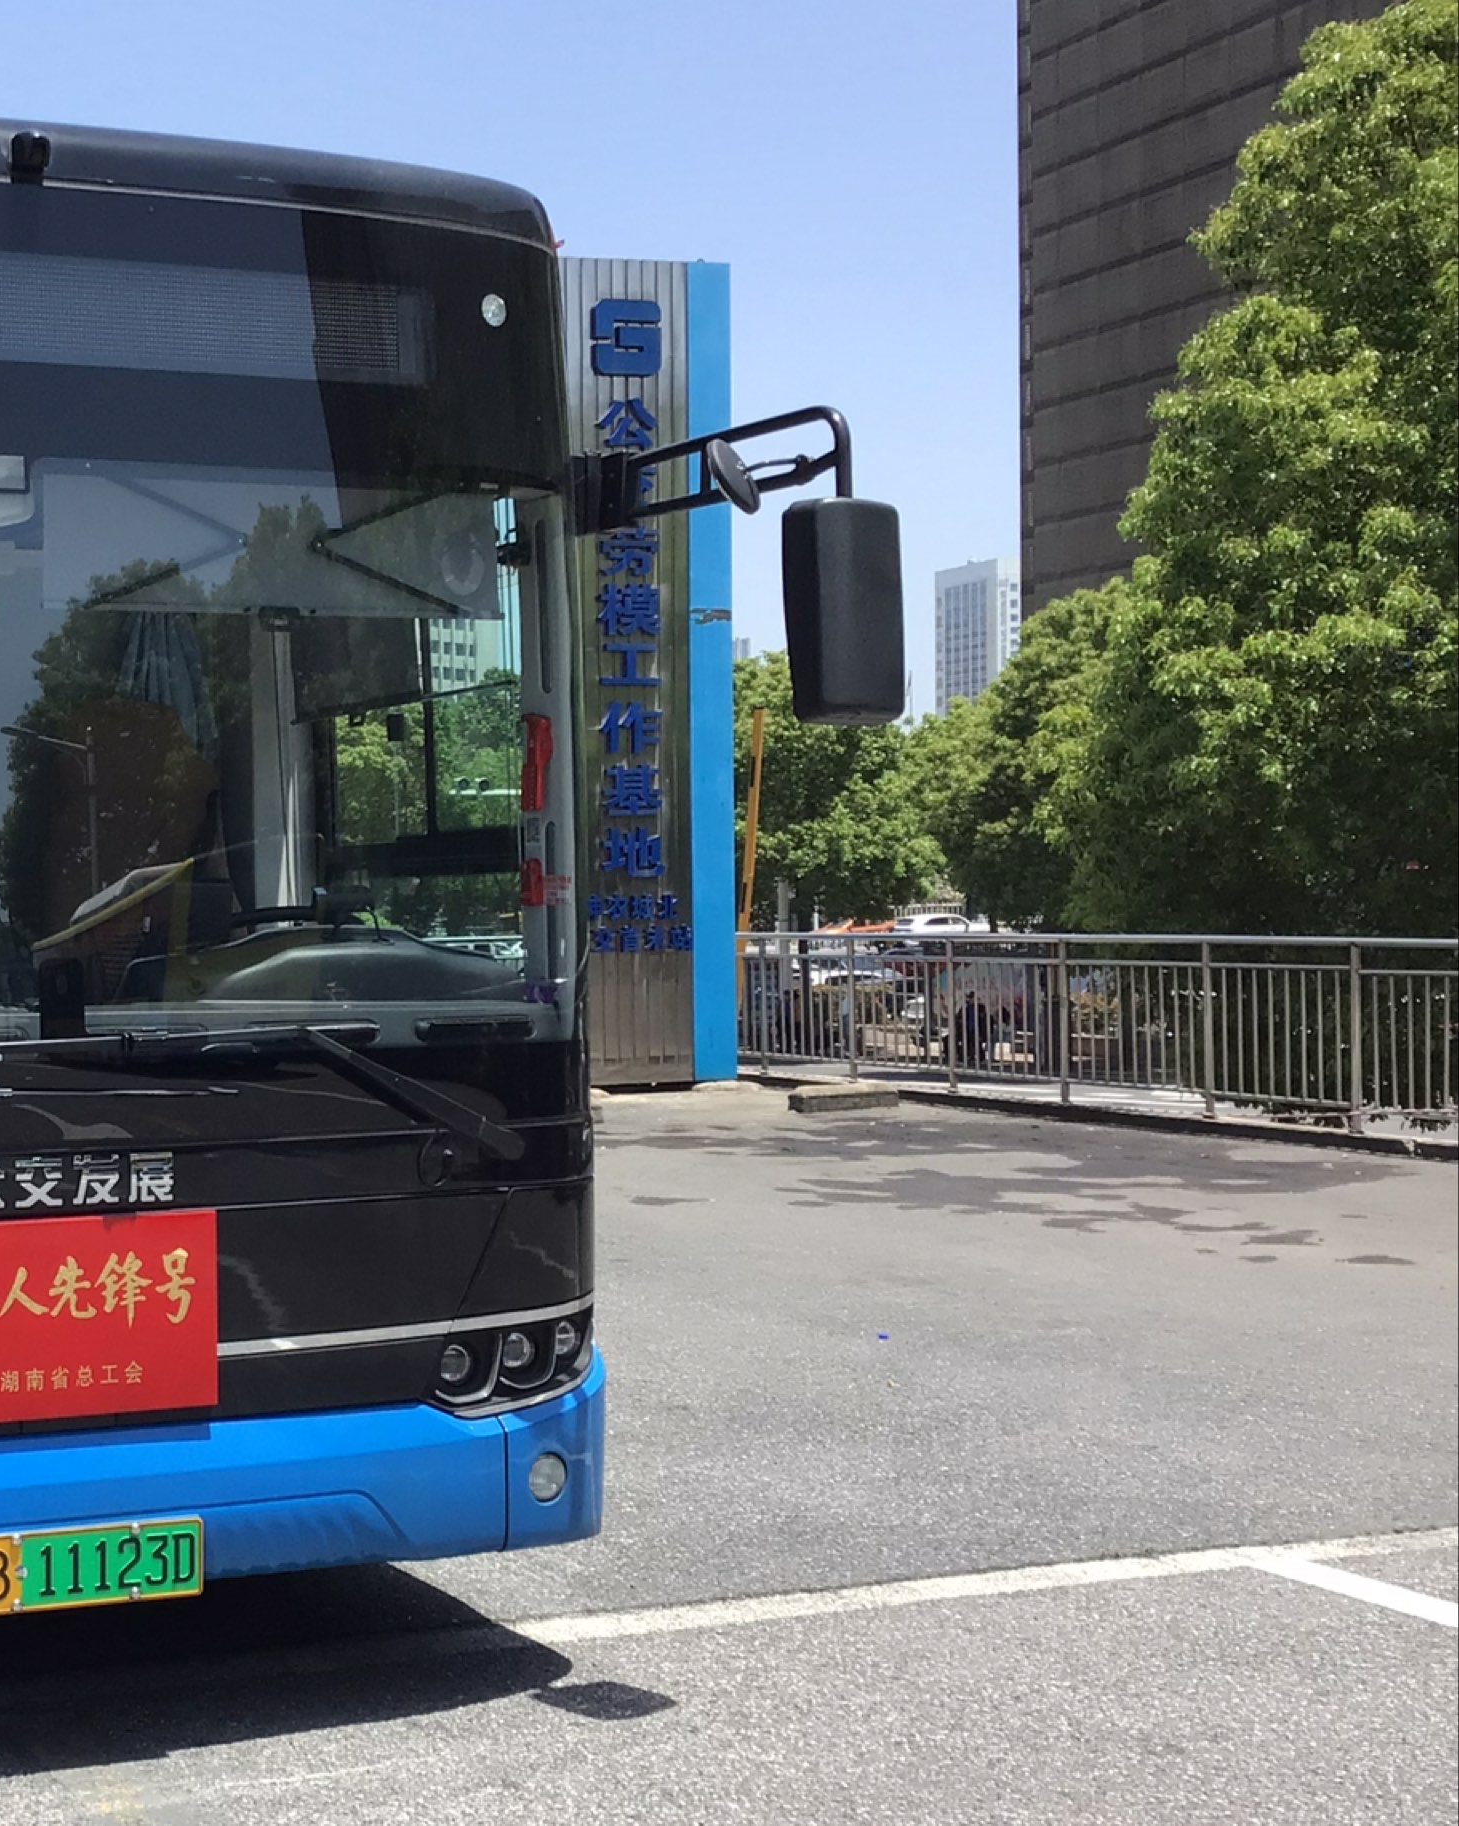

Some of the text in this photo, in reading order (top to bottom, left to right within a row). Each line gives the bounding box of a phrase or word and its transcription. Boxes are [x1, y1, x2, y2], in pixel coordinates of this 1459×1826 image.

[595, 398, 666, 878] 公劳模工作基地
[0, 1360, 143, 1393] 湖南省总工会
[39, 1531, 196, 1596] 11123D
